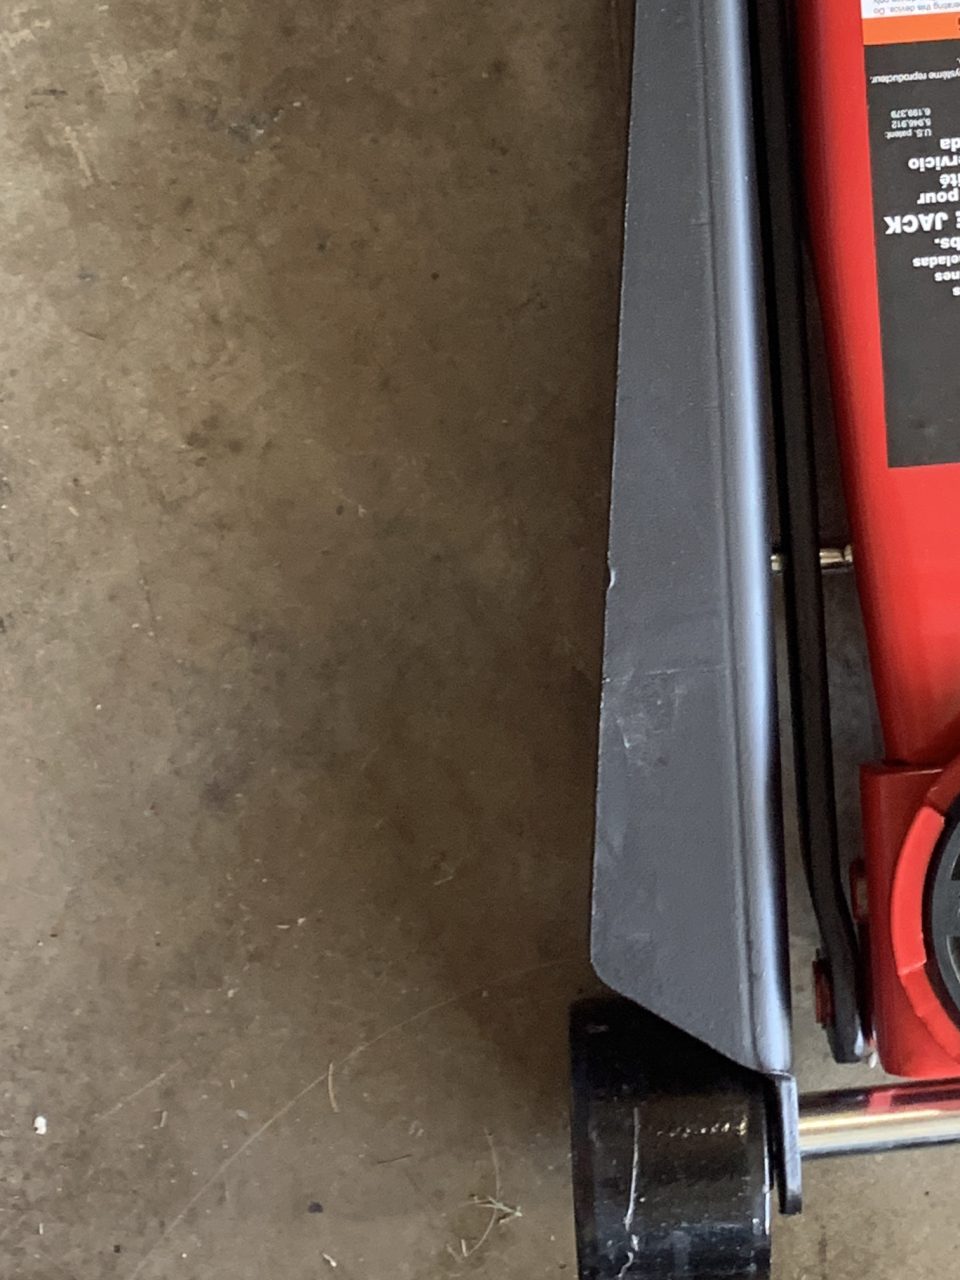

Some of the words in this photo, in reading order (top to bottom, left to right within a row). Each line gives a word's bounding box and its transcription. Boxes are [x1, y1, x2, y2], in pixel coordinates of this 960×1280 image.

[869, 70, 927, 85] reproducteur.
[915, 186, 959, 204] pour
[882, 210, 950, 234] JACK
